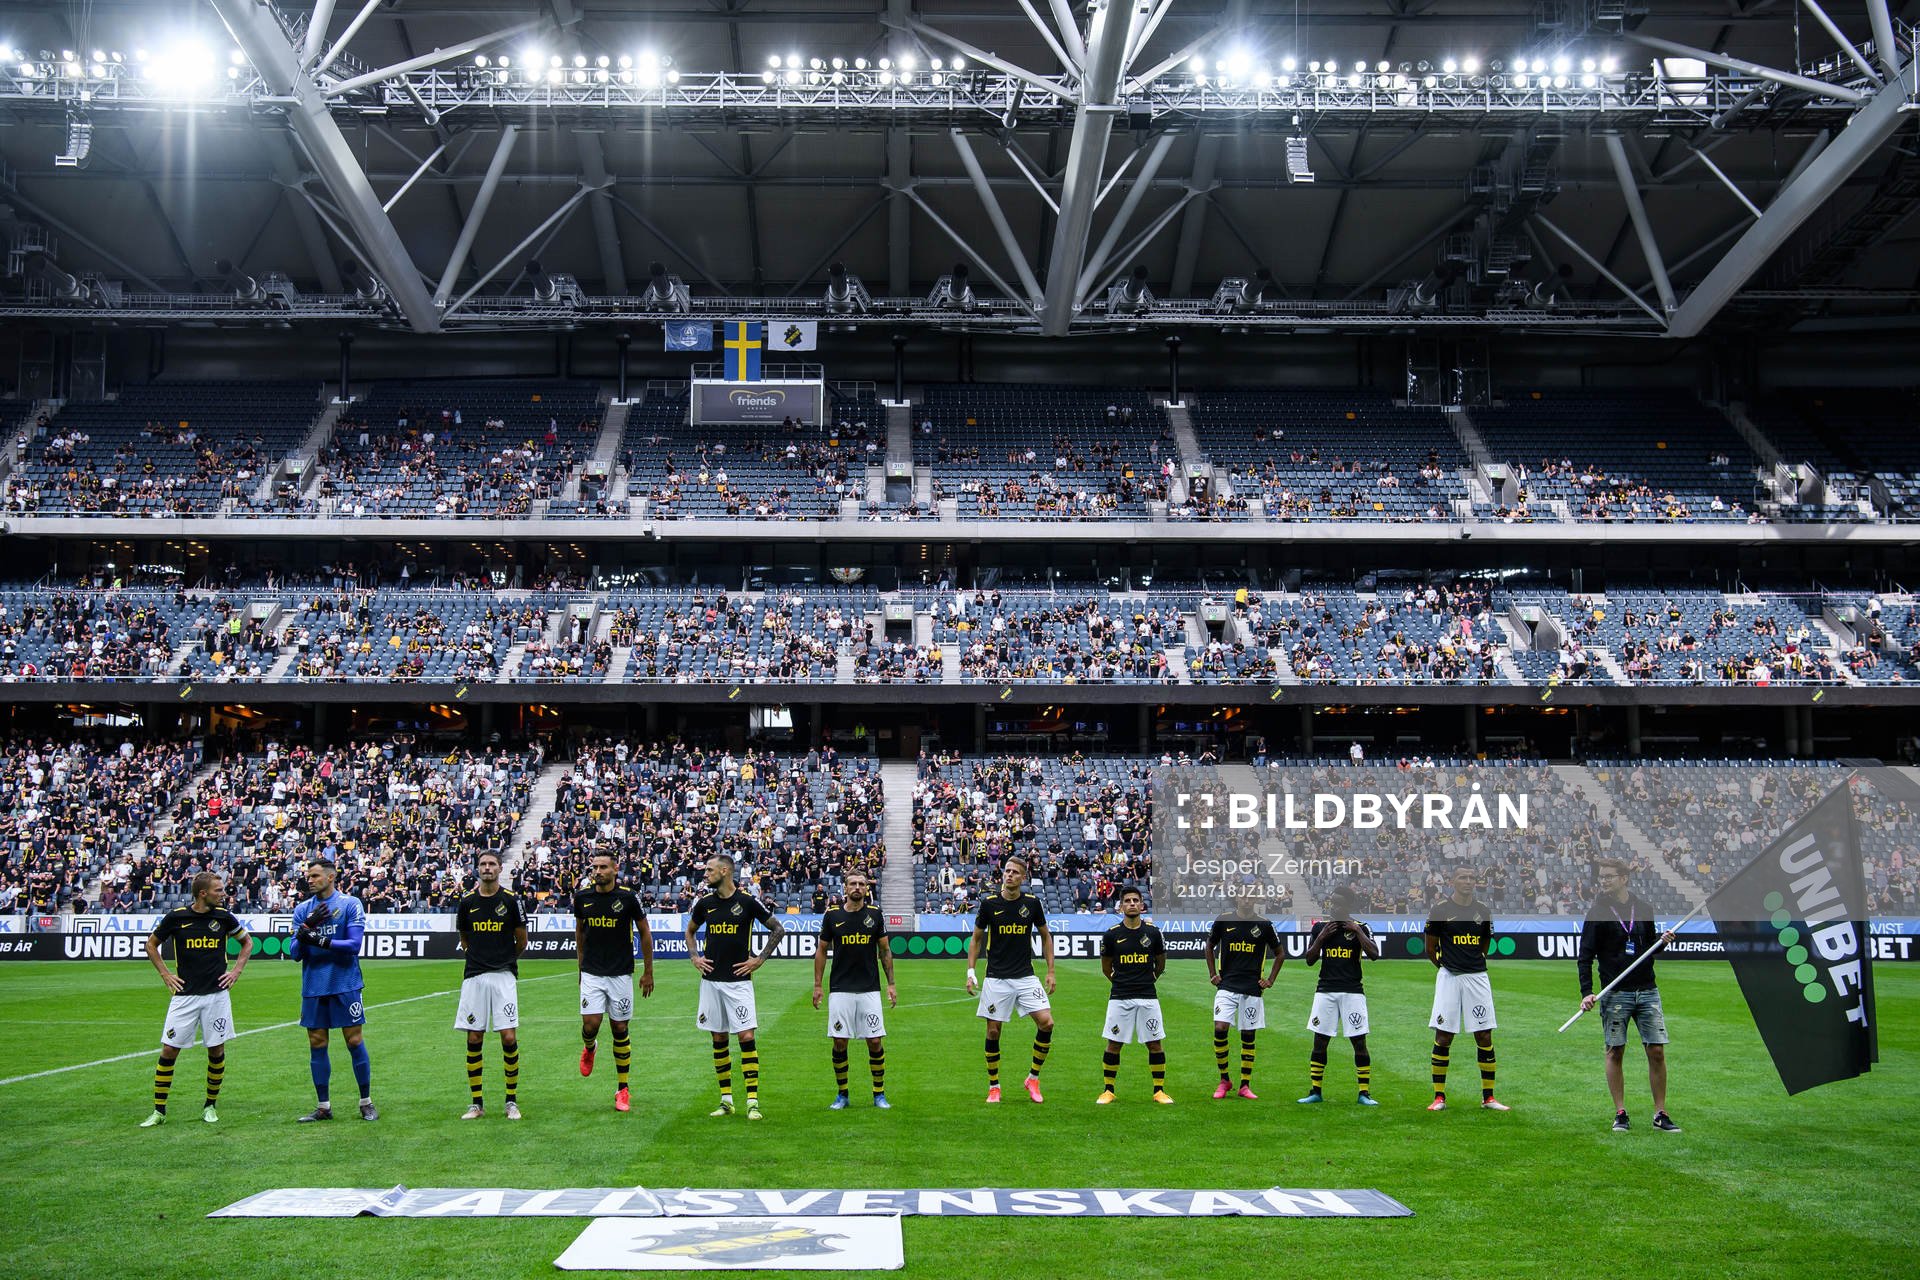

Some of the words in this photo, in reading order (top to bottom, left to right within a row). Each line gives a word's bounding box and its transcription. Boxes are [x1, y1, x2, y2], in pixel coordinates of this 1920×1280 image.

[737, 394, 777, 406] friends
[472, 919, 505, 932] notar
[588, 915, 618, 928] notar
[709, 921, 740, 934] notar
[316, 923, 338, 936] otar
[999, 922, 1028, 935] notar
[1779, 833, 1868, 1028] UNIBET
[186, 935, 220, 949] notar
[545, 940, 559, 951] 18
[560, 938, 577, 951] ÅR
[841, 932, 871, 945] notar
[1453, 933, 1480, 945] notar
[13, 939, 33, 952] ÅR
[64, 936, 149, 958] UNIBE
[1229, 940, 1255, 953] notar
[1326, 946, 1352, 958] notar
[1119, 952, 1149, 964] notar
[420, 1190, 1362, 1216] ALLSVENSKAN
